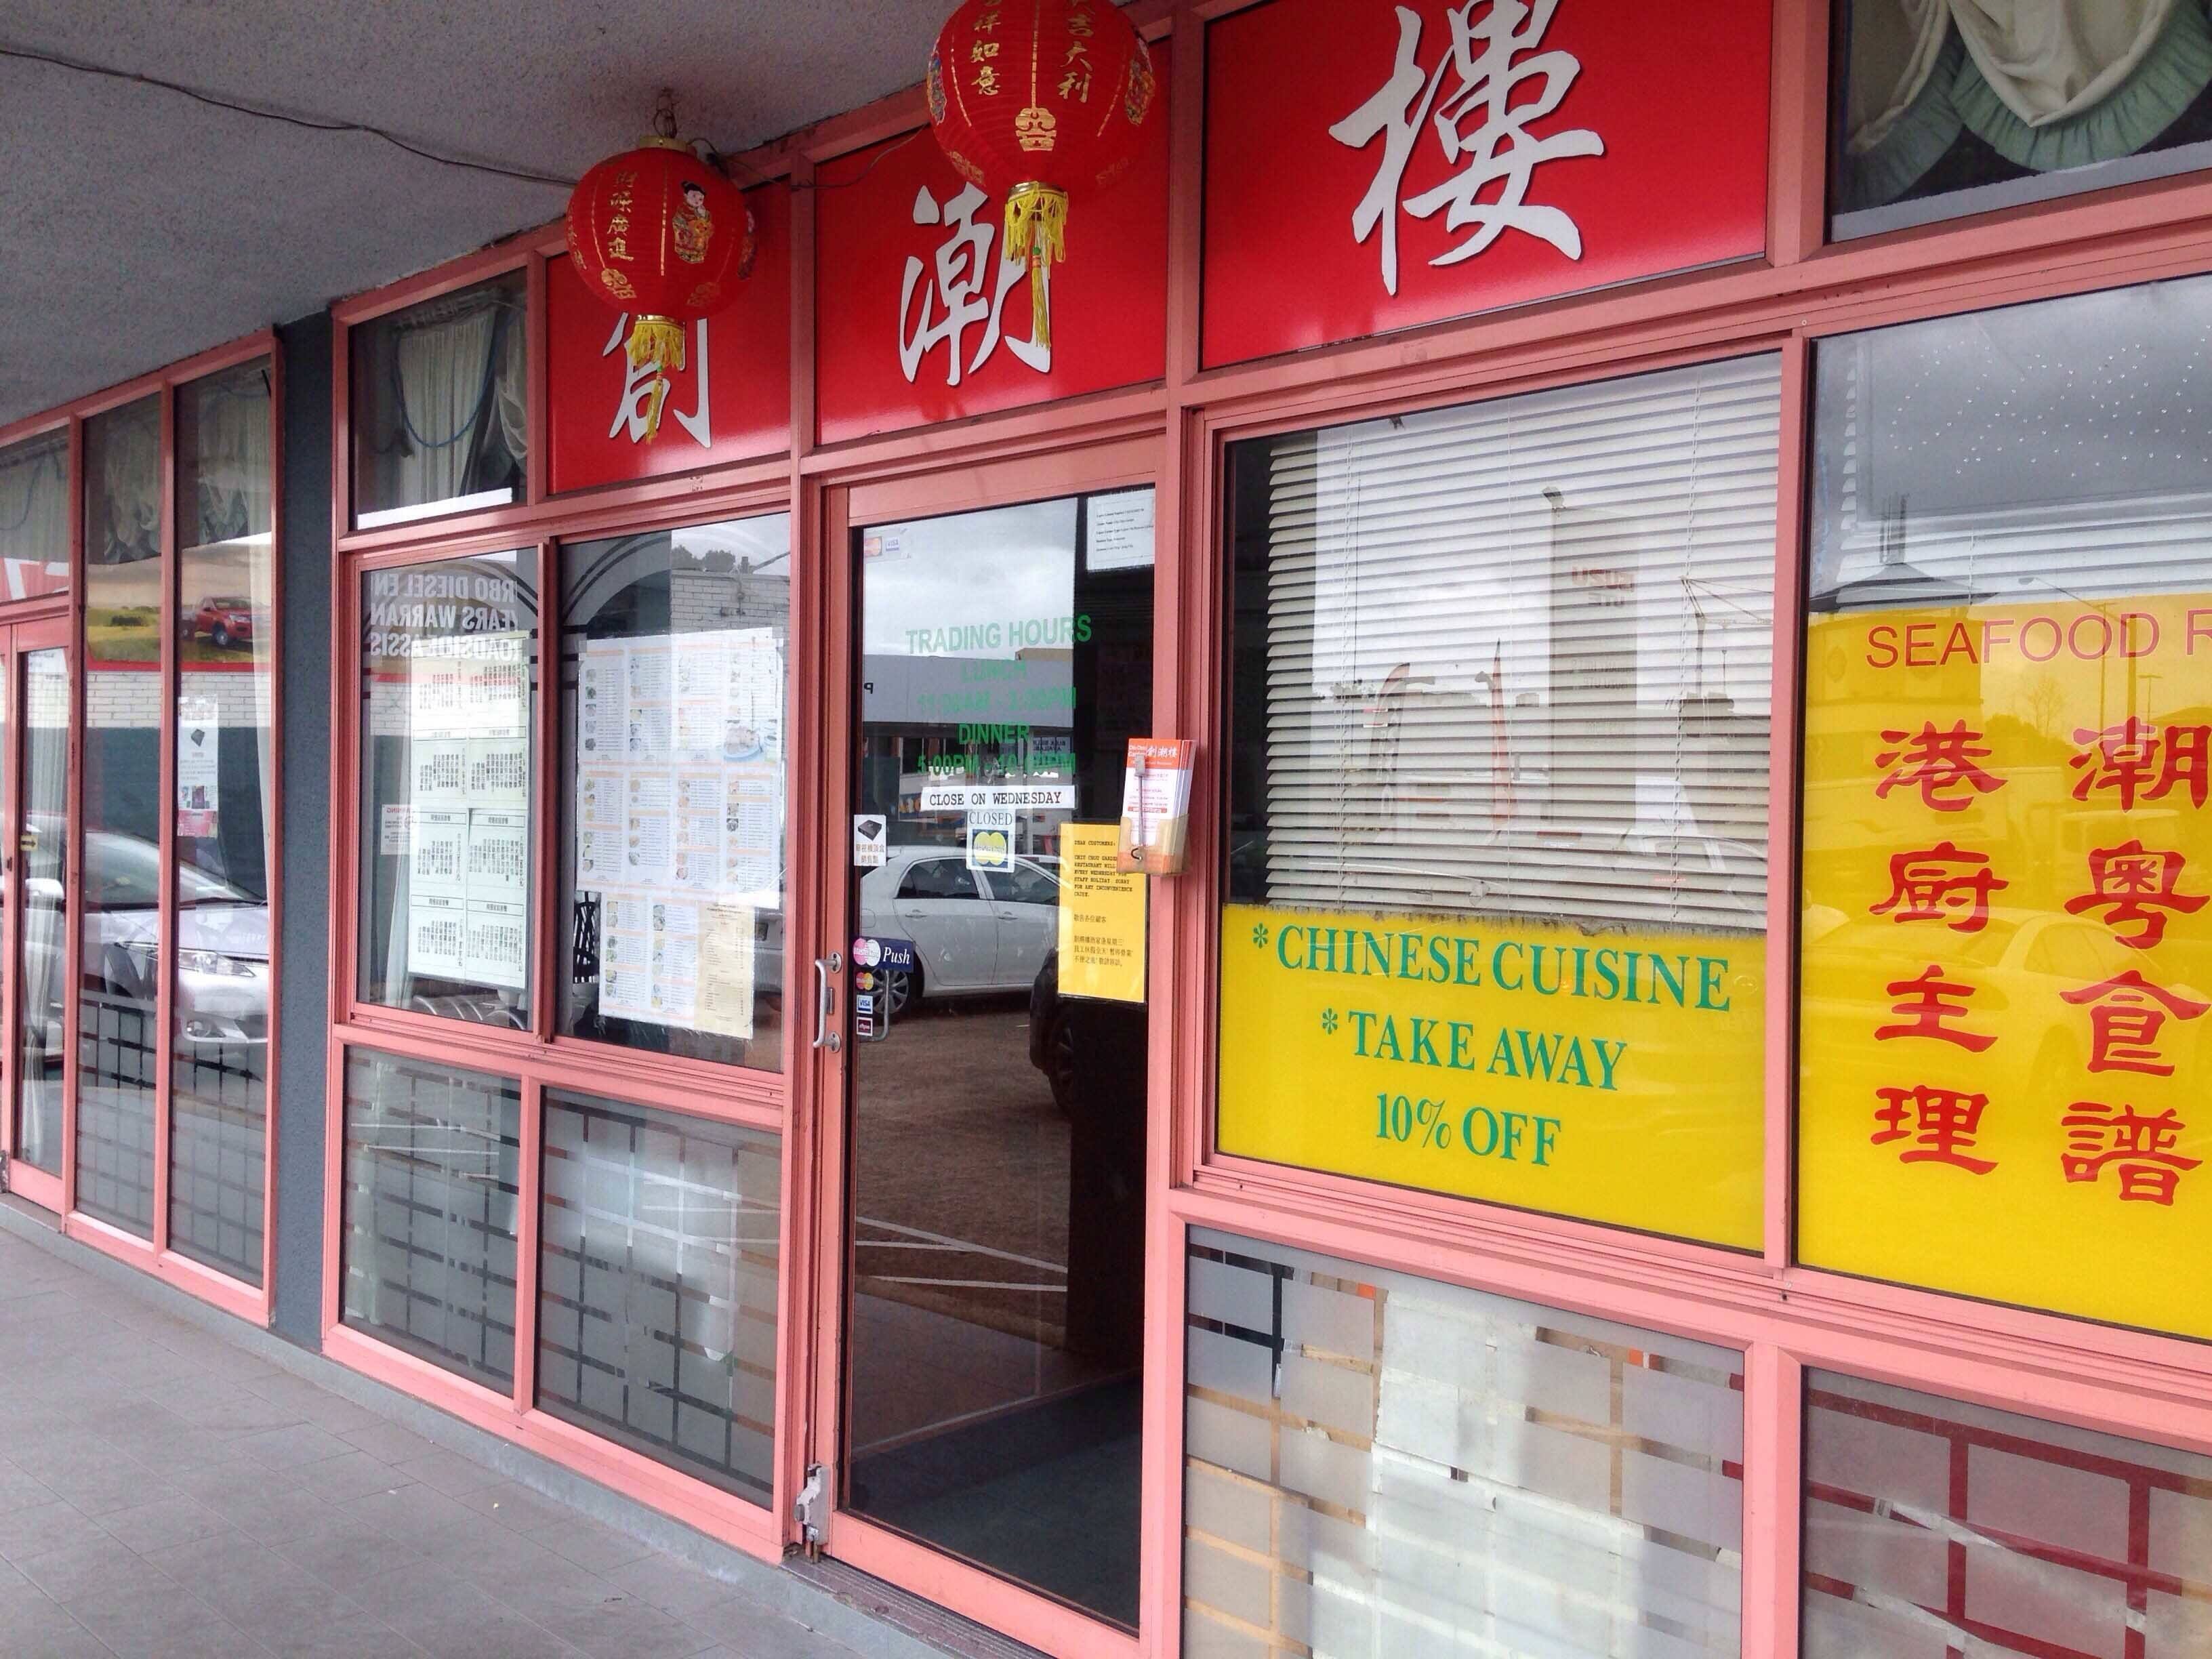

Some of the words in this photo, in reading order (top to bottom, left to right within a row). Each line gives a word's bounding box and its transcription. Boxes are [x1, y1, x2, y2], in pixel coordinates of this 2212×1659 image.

[905, 622, 1001, 655] TRADING
[1008, 614, 1092, 648] HOURS
[1866, 612, 2160, 669] SEAFOOD
[961, 659, 1027, 683] LUNCH
[957, 722, 1030, 745] DINNER
[929, 793, 965, 806] CLOSE
[971, 792, 986, 805] ON
[993, 791, 1063, 805] WEDNESDAY
[969, 812, 1013, 825] CLOSED
[883, 947, 910, 964] Push
[1277, 924, 1481, 986] CHINESE
[1492, 941, 1732, 1012] CUISINE
[1348, 1011, 1475, 1071] TAKE
[1486, 1027, 1628, 1092] AWAY
[1376, 1093, 1452, 1150] 10%
[1462, 1106, 1563, 1167] OFF
